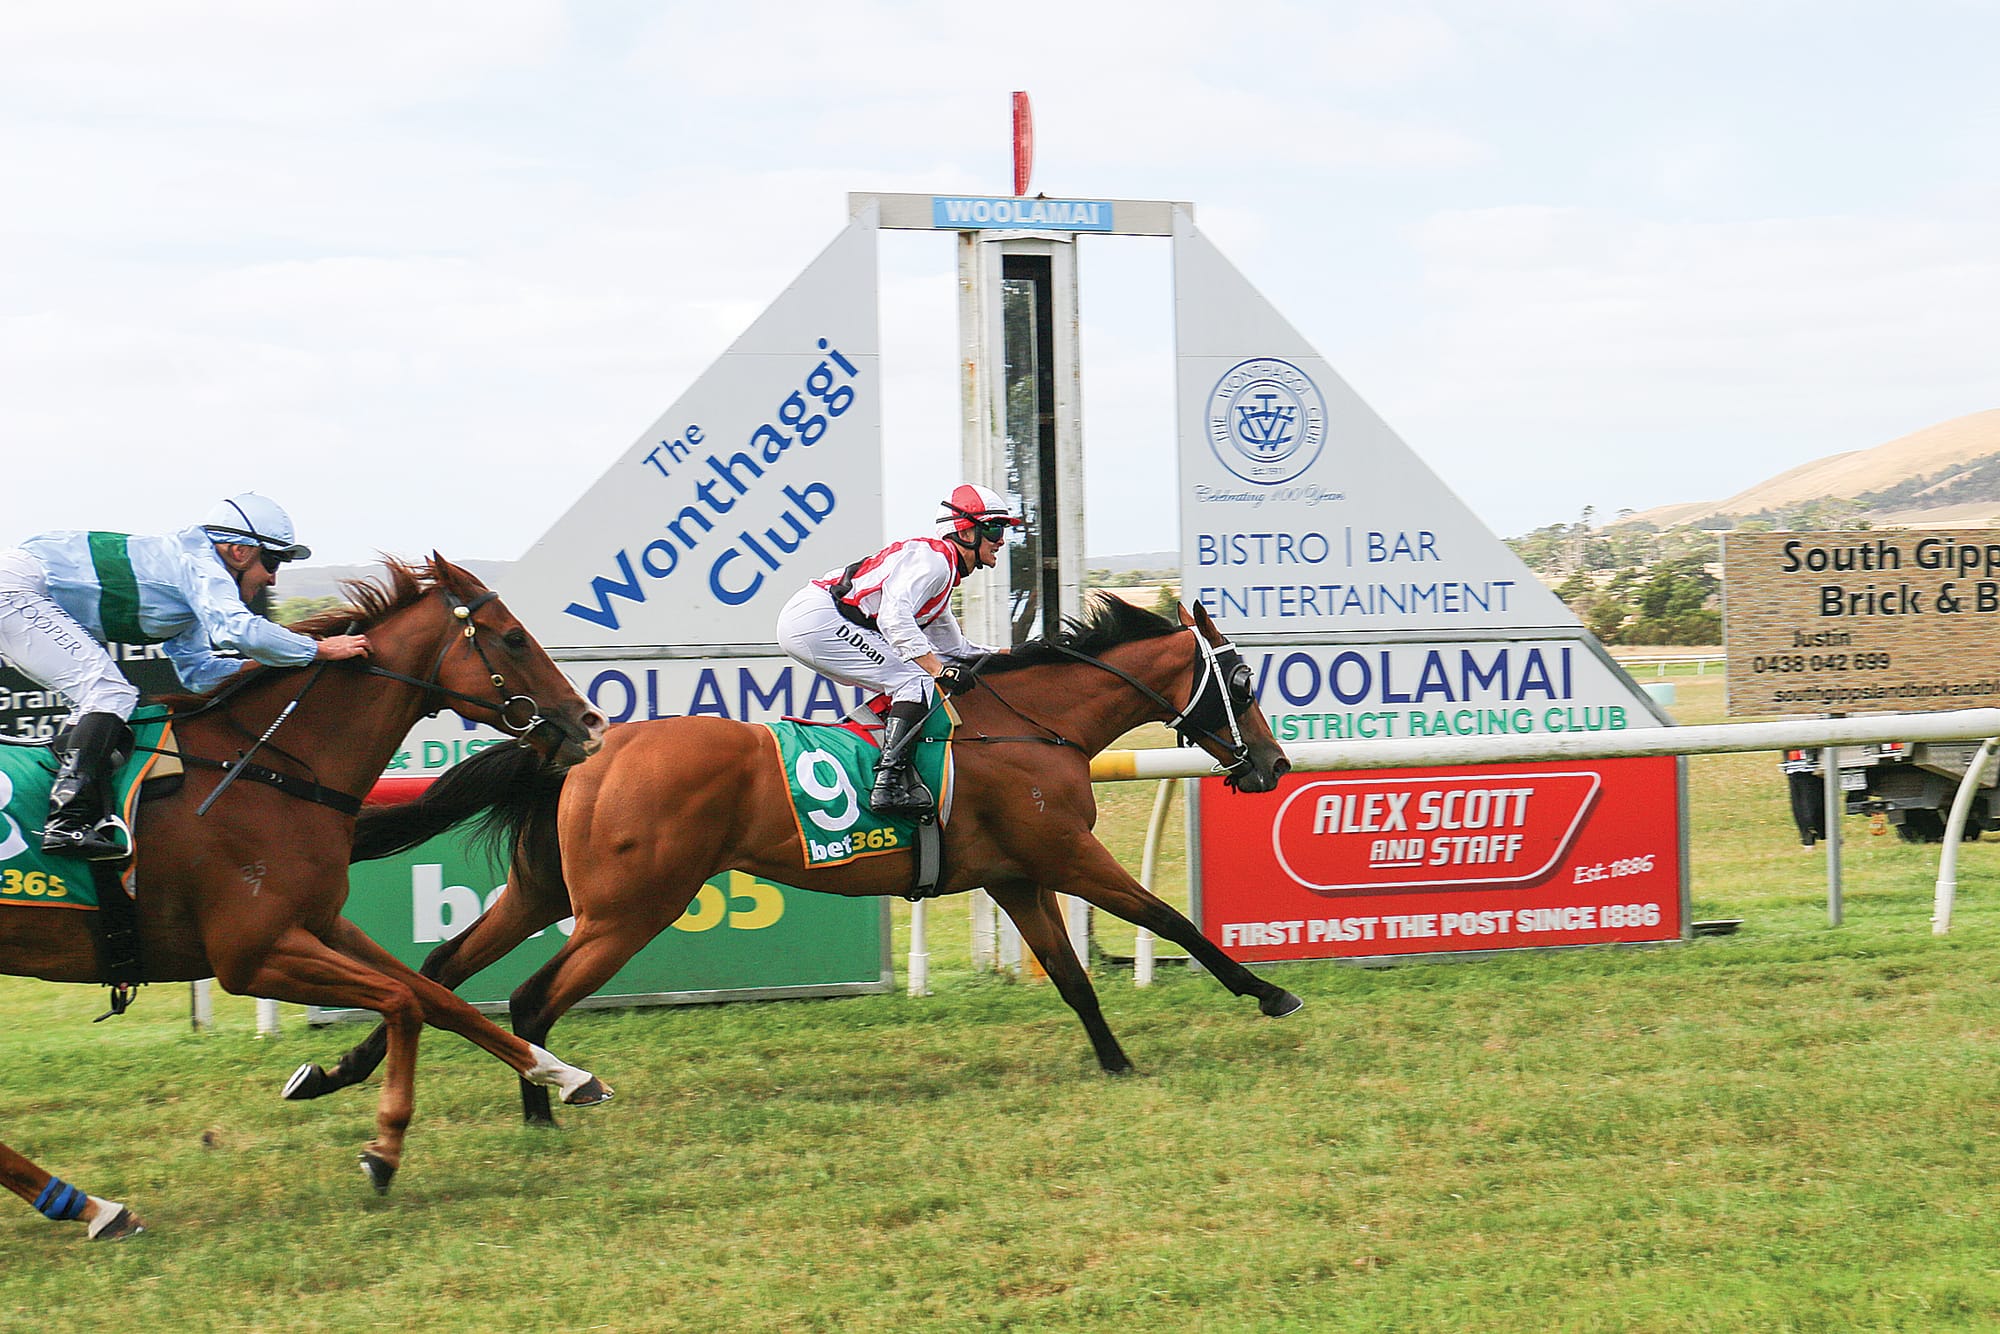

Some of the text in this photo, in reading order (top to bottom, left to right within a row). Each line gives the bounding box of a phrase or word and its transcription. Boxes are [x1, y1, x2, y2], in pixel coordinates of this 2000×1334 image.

[945, 200, 1099, 225] WOOLAMAI
[642, 424, 705, 477] The
[562, 337, 859, 631] Wonthaggi
[708, 482, 836, 606] Club
[1196, 530, 1441, 566] BISTRO BAR
[1781, 537, 2000, 578] South Gipp
[1199, 580, 1516, 619] ENTERTAINMENT
[1819, 583, 1922, 617] Brick
[1935, 582, 1962, 614] &
[836, 624, 885, 666] D.Dean
[1792, 628, 1851, 648] Justin
[1752, 652, 1891, 674] 0438 042 699
[1409, 707, 1533, 736] RACING
[1543, 705, 1629, 734] CLUB
[795, 748, 860, 832] 9
[1312, 788, 1535, 835] ALEX SCOTT
[809, 827, 898, 862] bet365
[1370, 834, 1523, 867] AND STAFF
[1221, 902, 1661, 949] FIRST PAST THE POST SINCE 1886
